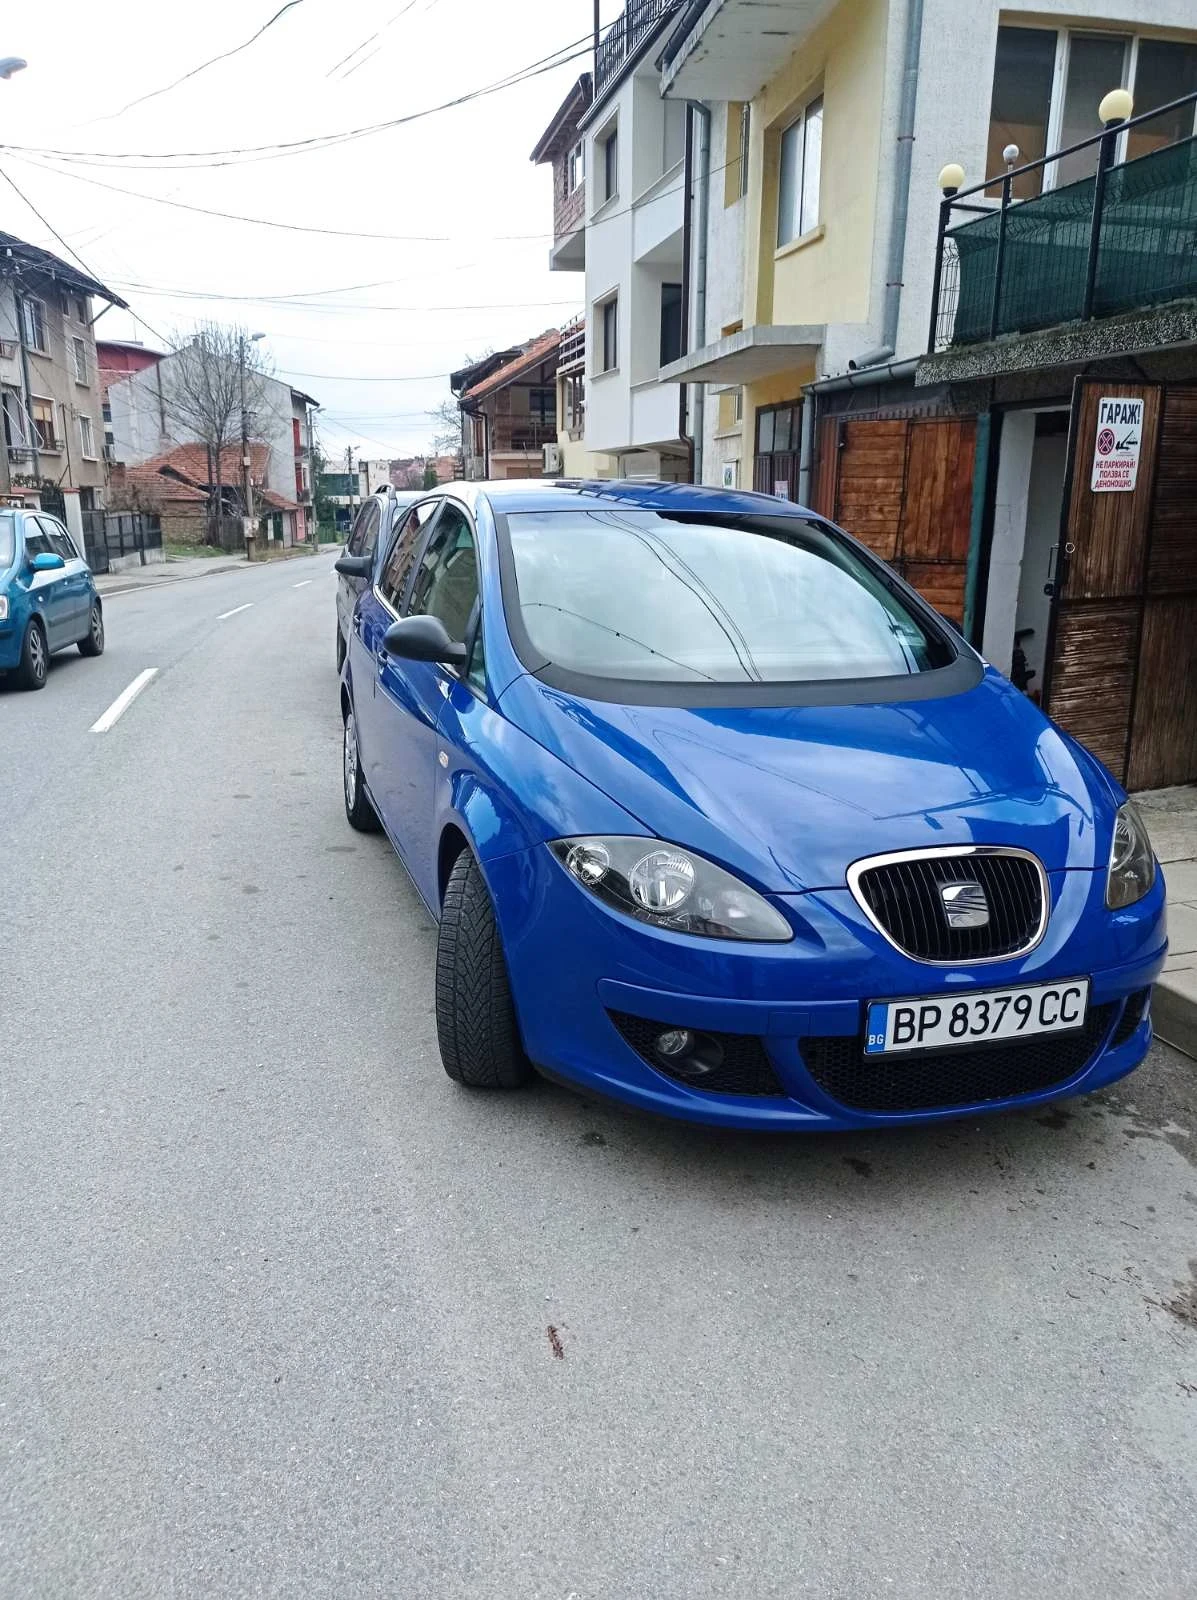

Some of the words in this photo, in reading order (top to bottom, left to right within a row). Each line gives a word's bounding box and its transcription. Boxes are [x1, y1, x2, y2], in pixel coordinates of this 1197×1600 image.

[1100, 403, 1141, 424] ГАРАЖ!
[1096, 461, 1103, 469] НЕ
[1099, 470, 1121, 478] ПОЛЗВА
[1122, 470, 1129, 478] СЕ
[1095, 479, 1131, 488] ДЕНОНОЩНО
[892, 1005, 941, 1044] BP
[949, 995, 1032, 1038] 8379
[1039, 987, 1081, 1026] CC
[868, 1034, 884, 1046] BG
